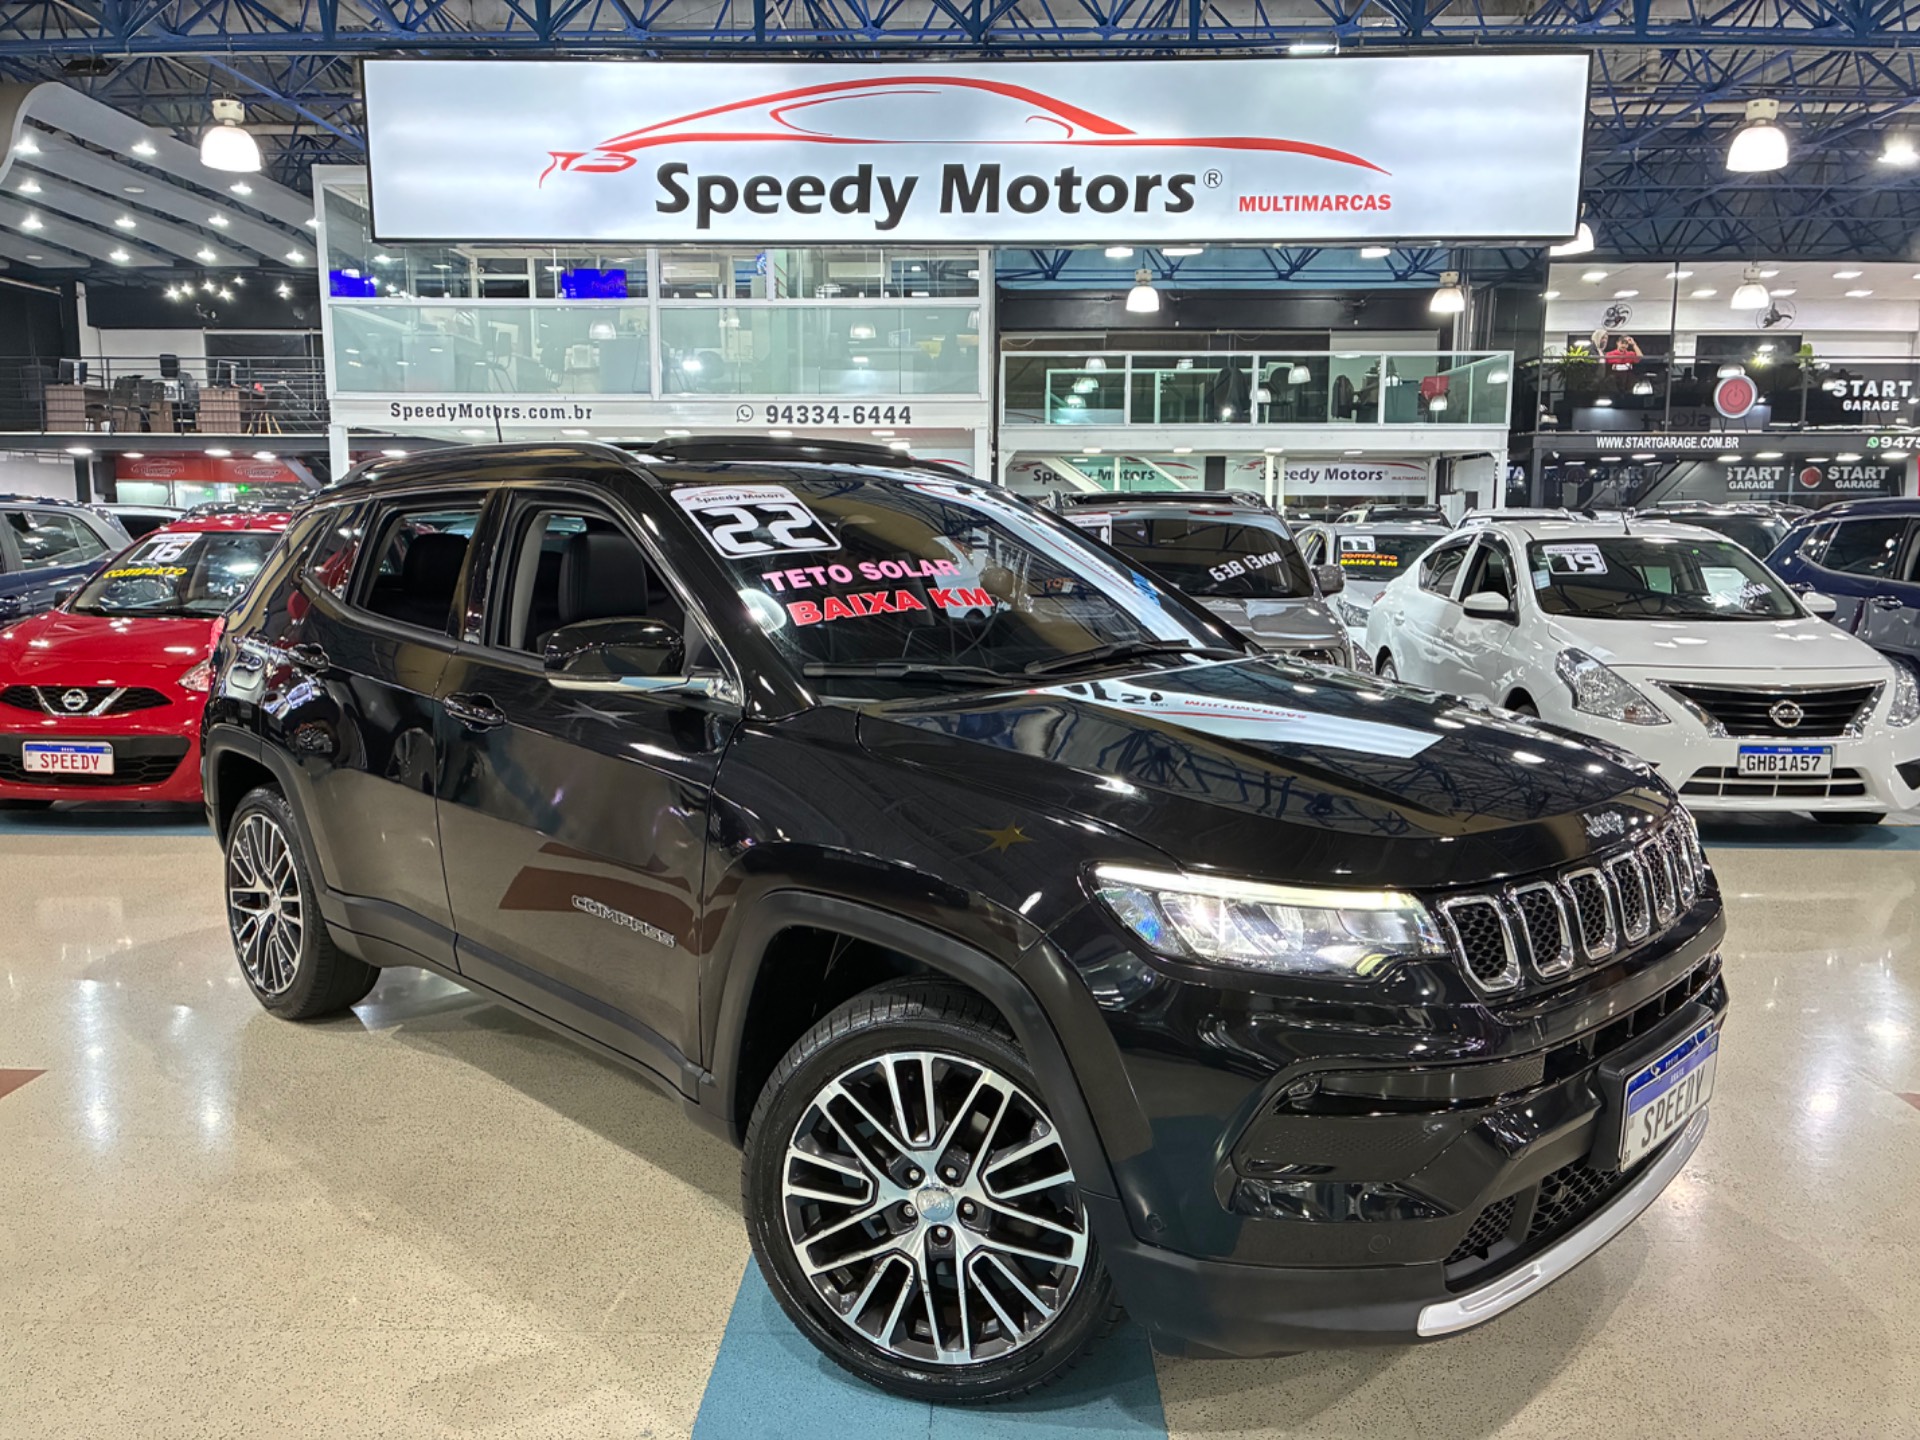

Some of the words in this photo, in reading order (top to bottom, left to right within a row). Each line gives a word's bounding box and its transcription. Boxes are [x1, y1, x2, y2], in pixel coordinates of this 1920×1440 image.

[655, 162, 919, 231] Speedy
[939, 163, 1197, 214] Motors
[1239, 194, 1392, 212] MULTIMARCAS
[1832, 380, 1913, 398] START
[390, 403, 592, 421] SpeedyMotors.com.br
[765, 404, 912, 424] 94334-6444
[1843, 400, 1900, 411] GARAGE
[1596, 436, 1740, 449] WWW.STARTGARAGE.COM.BR
[1324, 467, 1384, 481] Motors
[1827, 466, 1889, 480] START
[1728, 480, 1775, 490] GARAGE
[1835, 480, 1881, 489] GARAGE
[700, 503, 830, 553] 22
[147, 541, 191, 562] 16
[1560, 553, 1604, 574] 19
[761, 564, 853, 592] TETO
[857, 558, 961, 581] SOLAR
[786, 588, 927, 627] BAIXA
[926, 586, 995, 608] KM
[40, 753, 99, 770] SPEEDY
[1746, 755, 1822, 772] GHB1A57
[571, 894, 677, 949] COMPASS
[1641, 1063, 1706, 1149] SPEEDY
